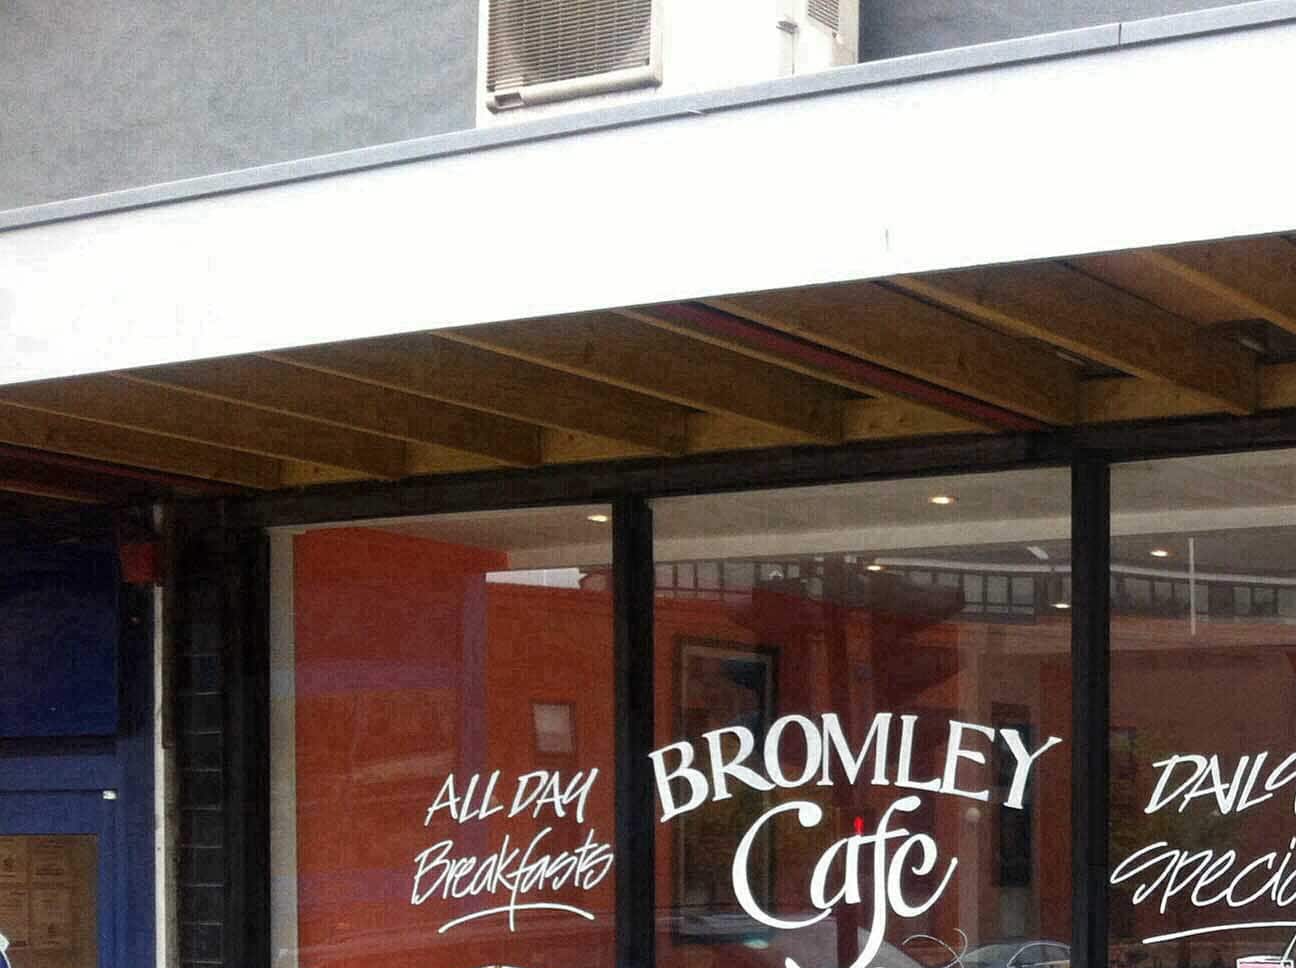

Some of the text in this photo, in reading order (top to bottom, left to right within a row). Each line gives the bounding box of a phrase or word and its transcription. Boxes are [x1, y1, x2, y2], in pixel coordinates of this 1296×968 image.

[424, 767, 599, 827] ALL DAY
[648, 712, 1063, 823] BROMLEY
[411, 828, 614, 932] Breakfasts
